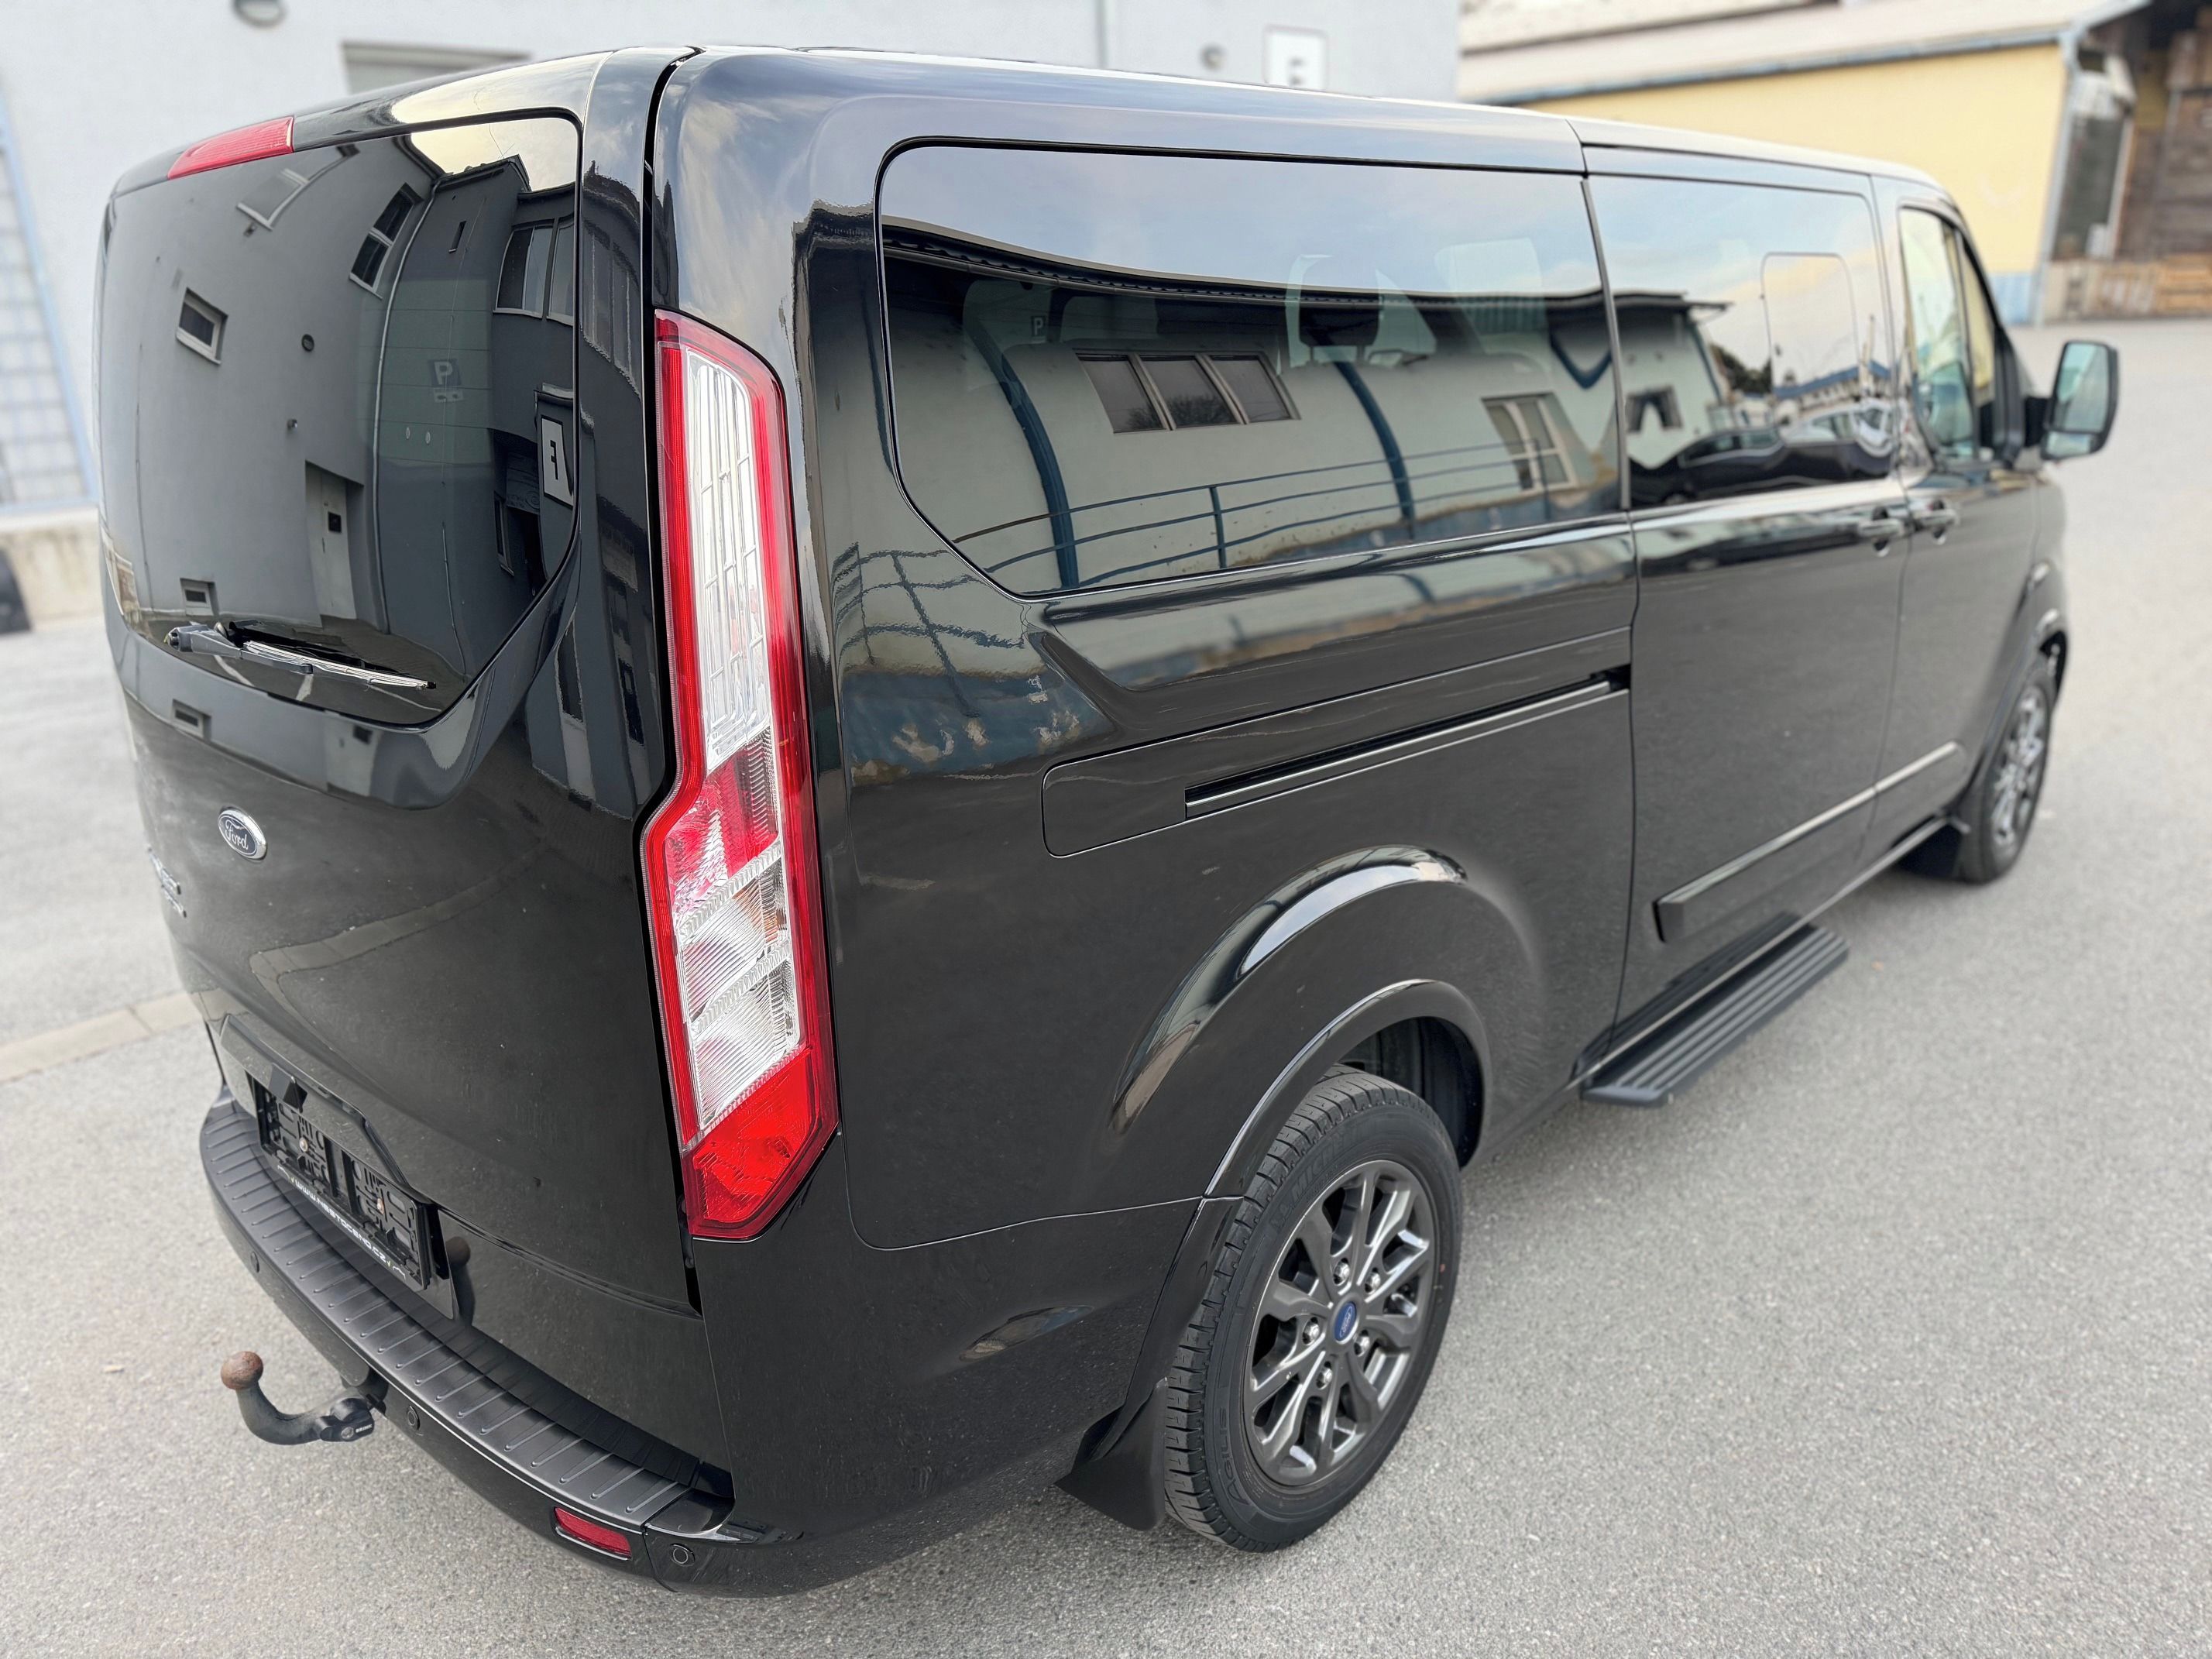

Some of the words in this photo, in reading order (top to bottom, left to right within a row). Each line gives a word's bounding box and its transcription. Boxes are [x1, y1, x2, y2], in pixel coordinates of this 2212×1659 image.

[1034, 317, 1044, 335] P
[434, 361, 453, 385] P
[225, 819, 249, 850] Ford
[1220, 1407, 1251, 1506] AGILIS
